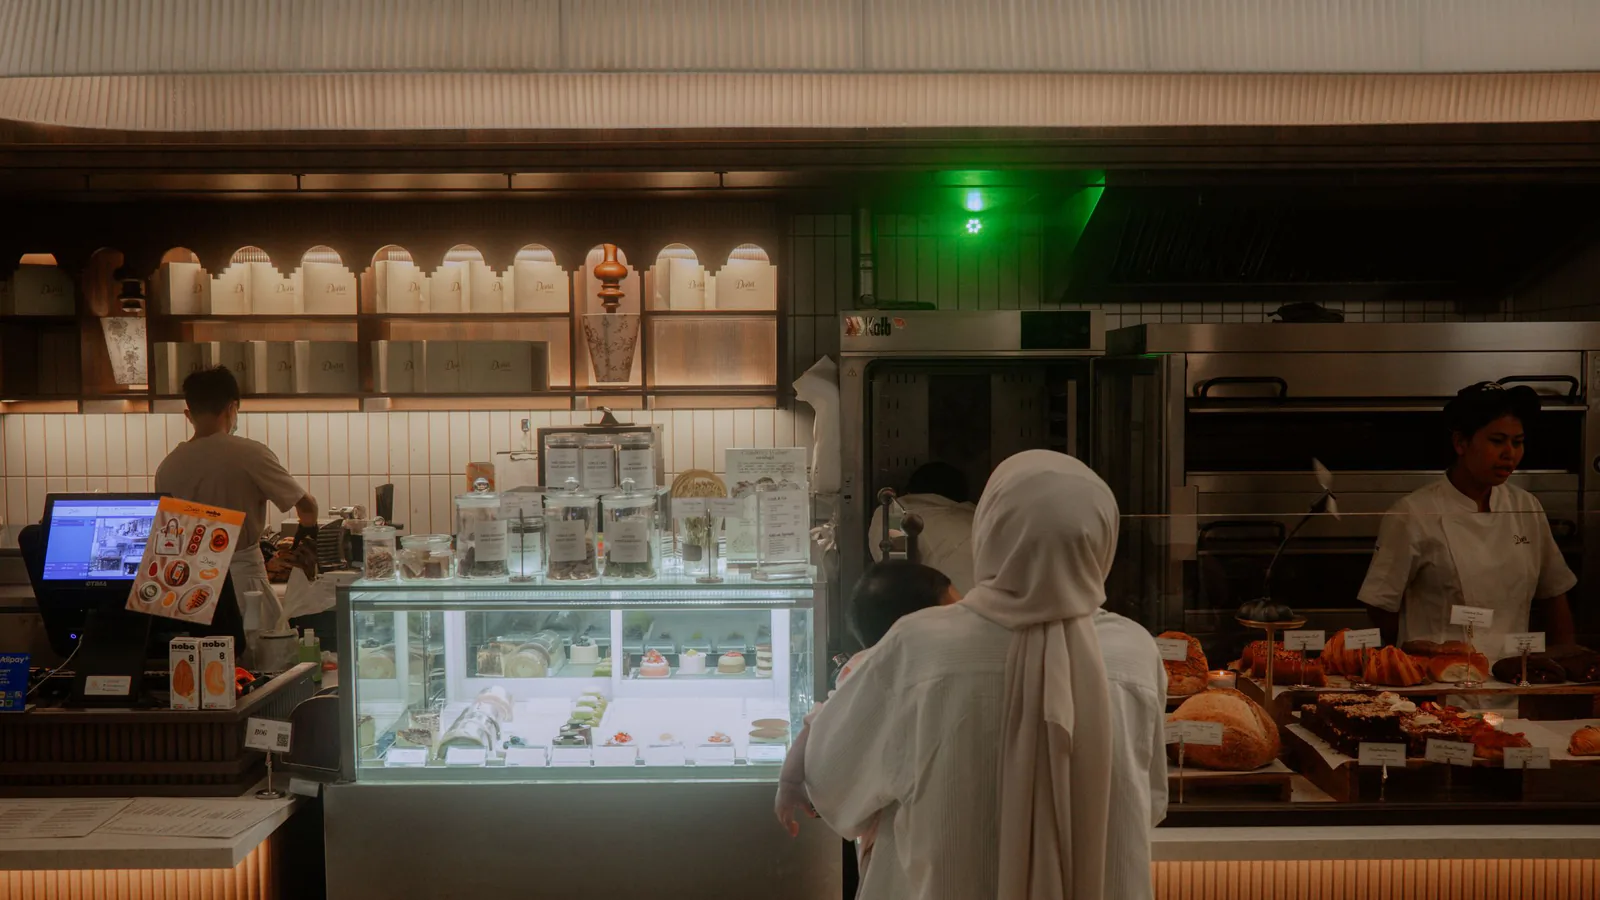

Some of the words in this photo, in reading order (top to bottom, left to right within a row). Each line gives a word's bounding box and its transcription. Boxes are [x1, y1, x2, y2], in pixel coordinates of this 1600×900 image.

[202, 640, 226, 648] nobo
[188, 654, 194, 662] 8
[219, 652, 225, 660] 8
[254, 728, 268, 737] B06
